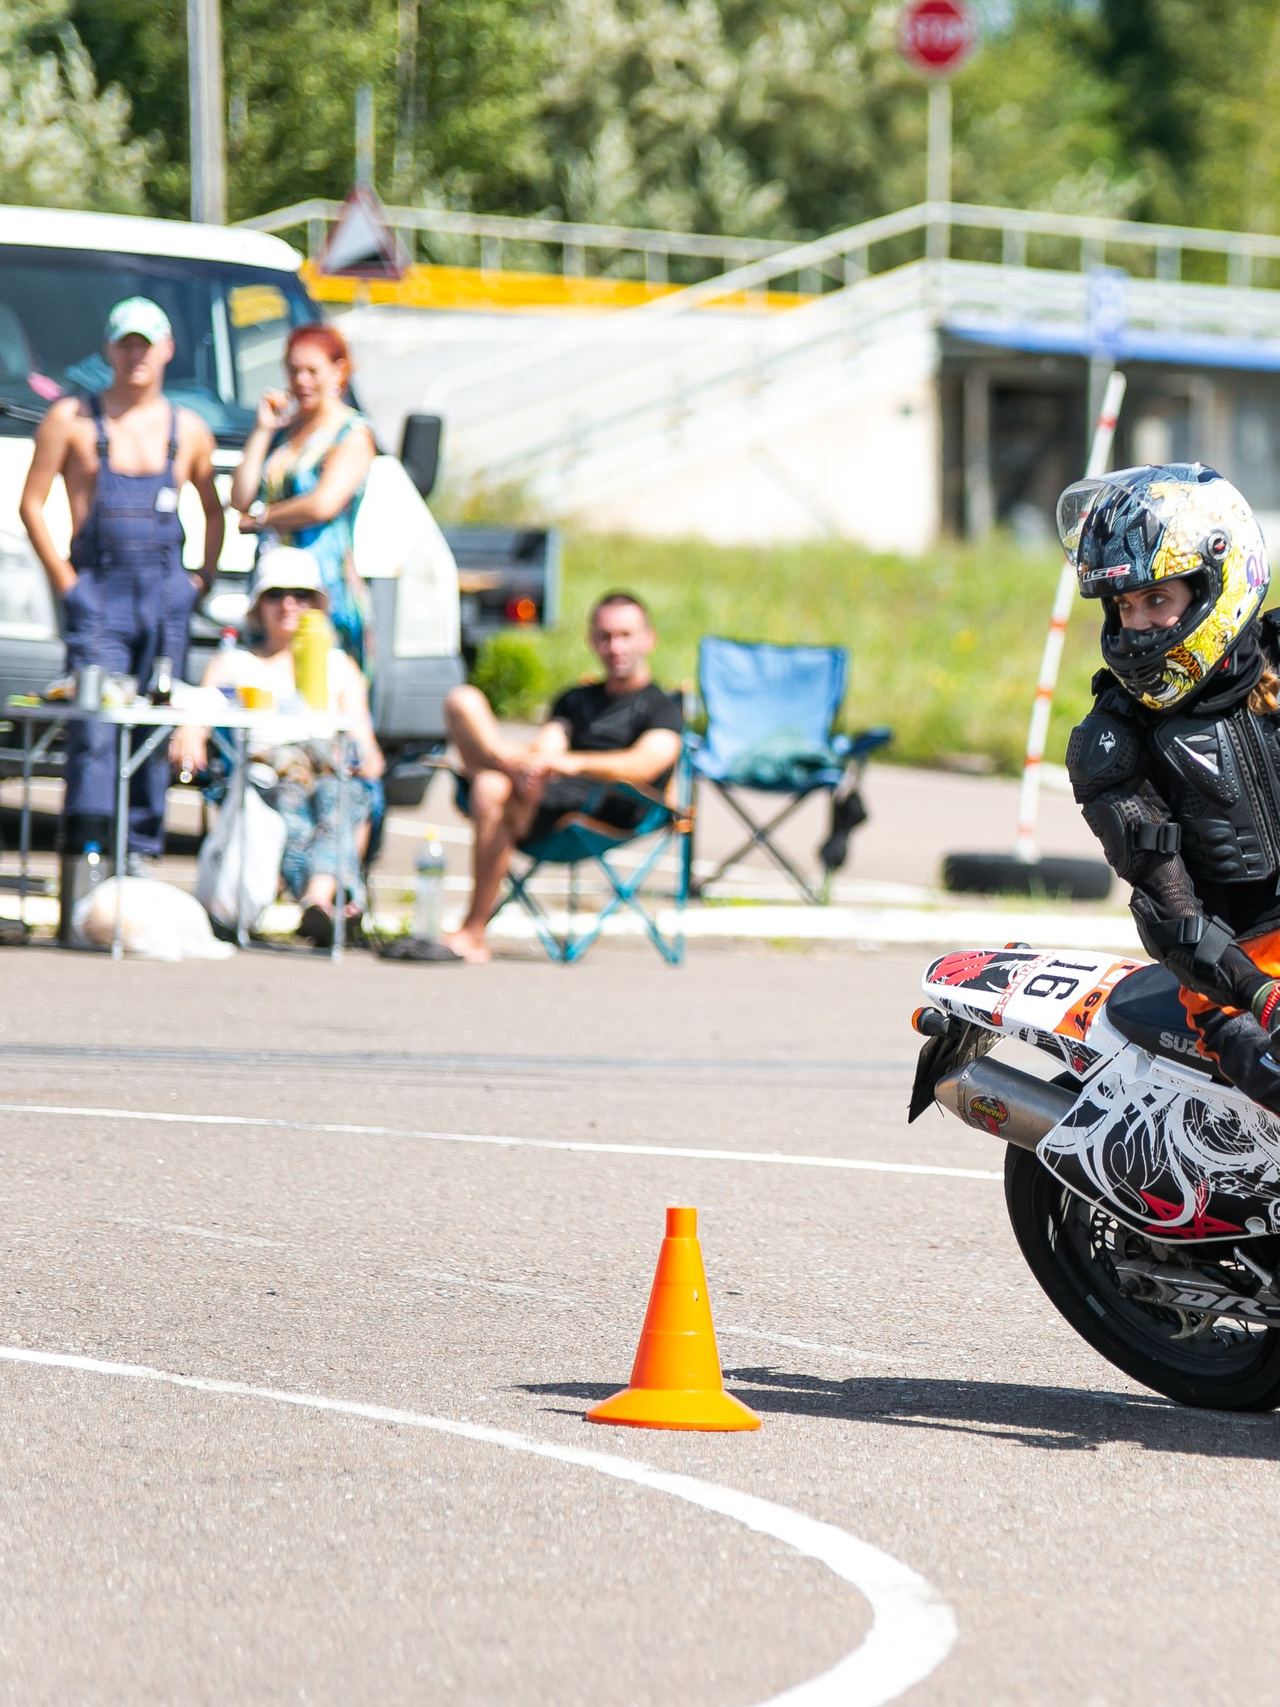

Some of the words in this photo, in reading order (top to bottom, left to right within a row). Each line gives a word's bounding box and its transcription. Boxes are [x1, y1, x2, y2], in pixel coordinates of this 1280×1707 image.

[1082, 563, 1131, 583] LS2
[1023, 959, 1098, 1001] 16
[1159, 1031, 1213, 1062] SUZ
